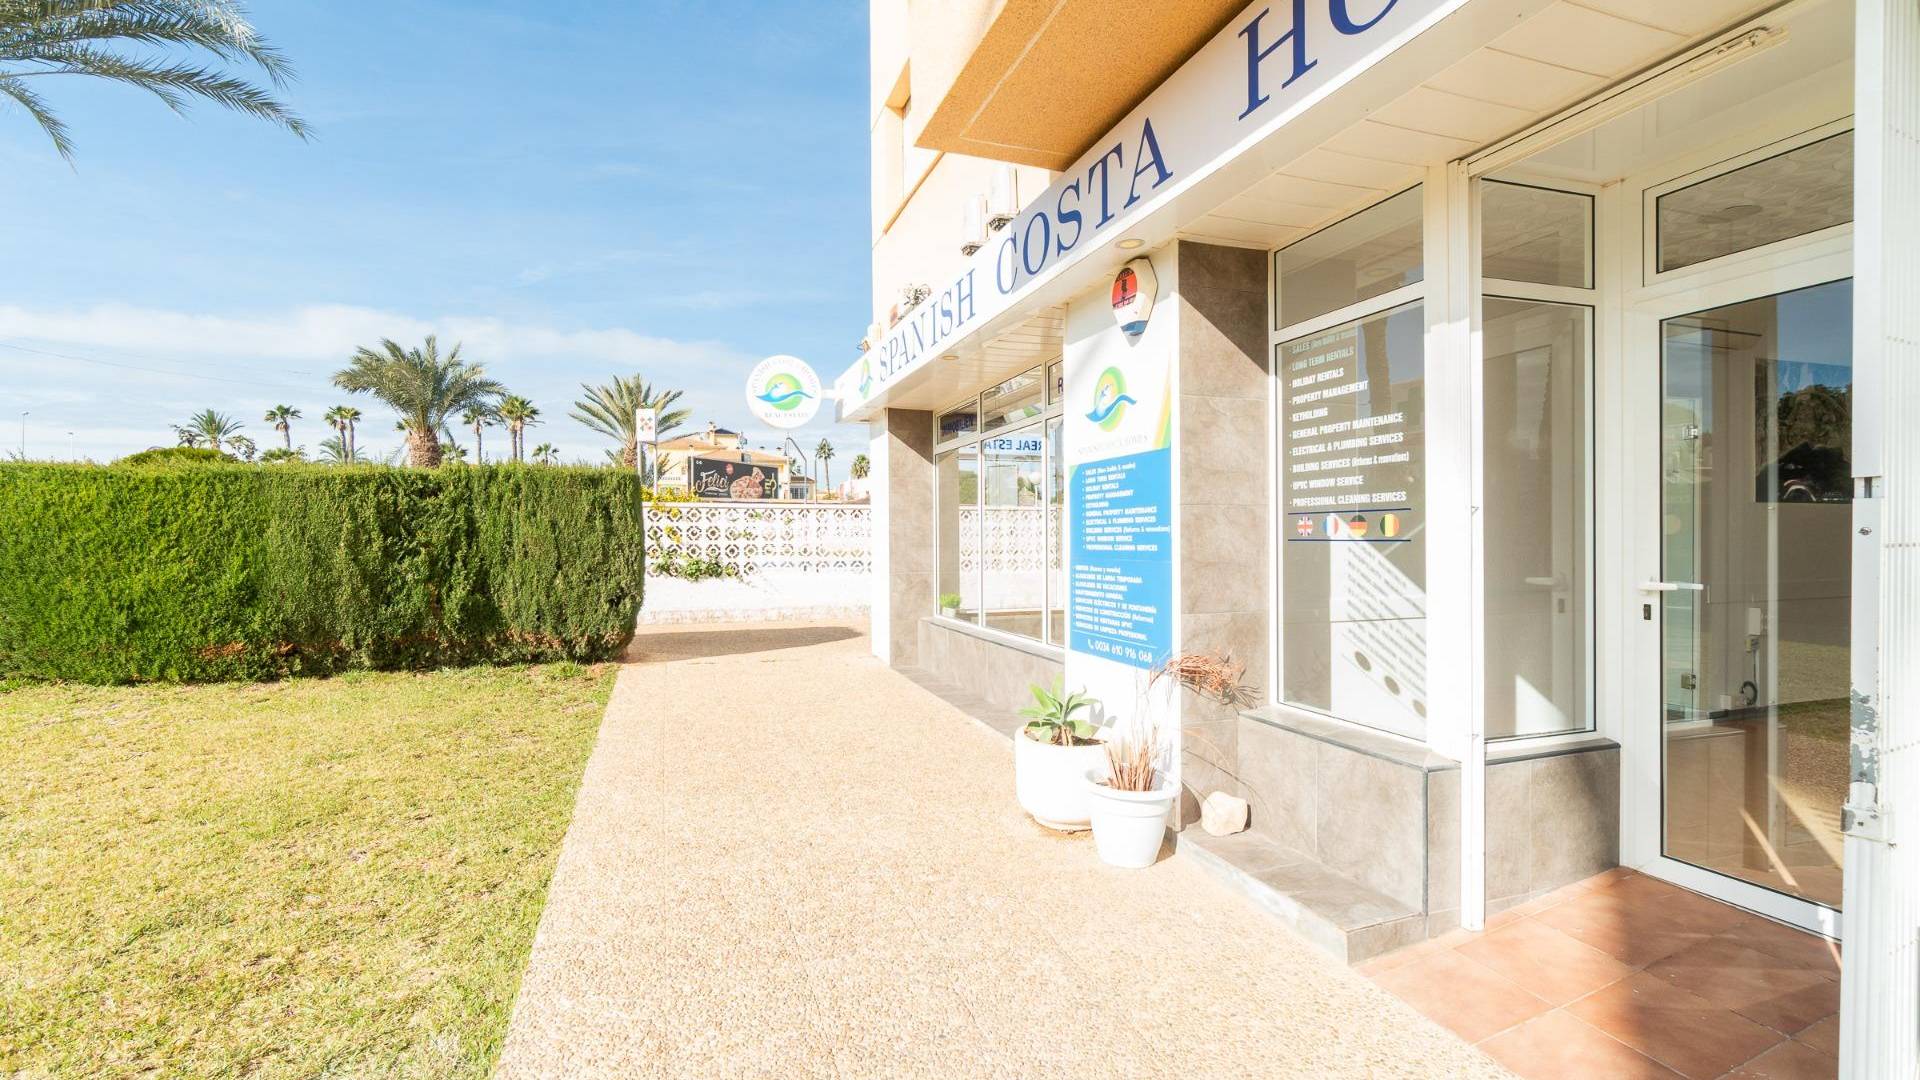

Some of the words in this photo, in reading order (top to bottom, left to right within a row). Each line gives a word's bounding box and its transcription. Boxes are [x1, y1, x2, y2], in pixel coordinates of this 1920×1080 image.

[879, 267, 976, 383] SPANISH
[996, 117, 1174, 295] COSTA
[1293, 342, 1310, 354] SALES
[1292, 360, 1307, 372] LONG
[1309, 355, 1325, 367] TERM
[1327, 346, 1354, 362] RENTALS
[1292, 374, 1316, 388] HOLIDAY
[1317, 367, 1344, 382] RENTALS
[1292, 390, 1322, 405] PROPERTY
[1323, 380, 1368, 398] MANAGEMENT
[1292, 408, 1328, 422] KEYHOLDING
[1293, 427, 1318, 439] GENERAL
[1319, 422, 1351, 434] PROPERTY
[1352, 412, 1404, 429] MAINTENANCE
[1293, 444, 1325, 456] ELECTRICAL
[1333, 437, 1368, 450] PLUMBING
[1369, 432, 1404, 445] SERVICES
[1293, 462, 1319, 473] BUILDING
[1321, 458, 1350, 470] SERVICES
[1292, 480, 1308, 490] UPVC
[1309, 478, 1335, 488] WINDOW
[1337, 475, 1364, 486] SERVICE
[1292, 496, 1336, 507] PROFESSIONAL
[1338, 493, 1371, 505] CLEANING
[1372, 490, 1407, 503] SERVICES
